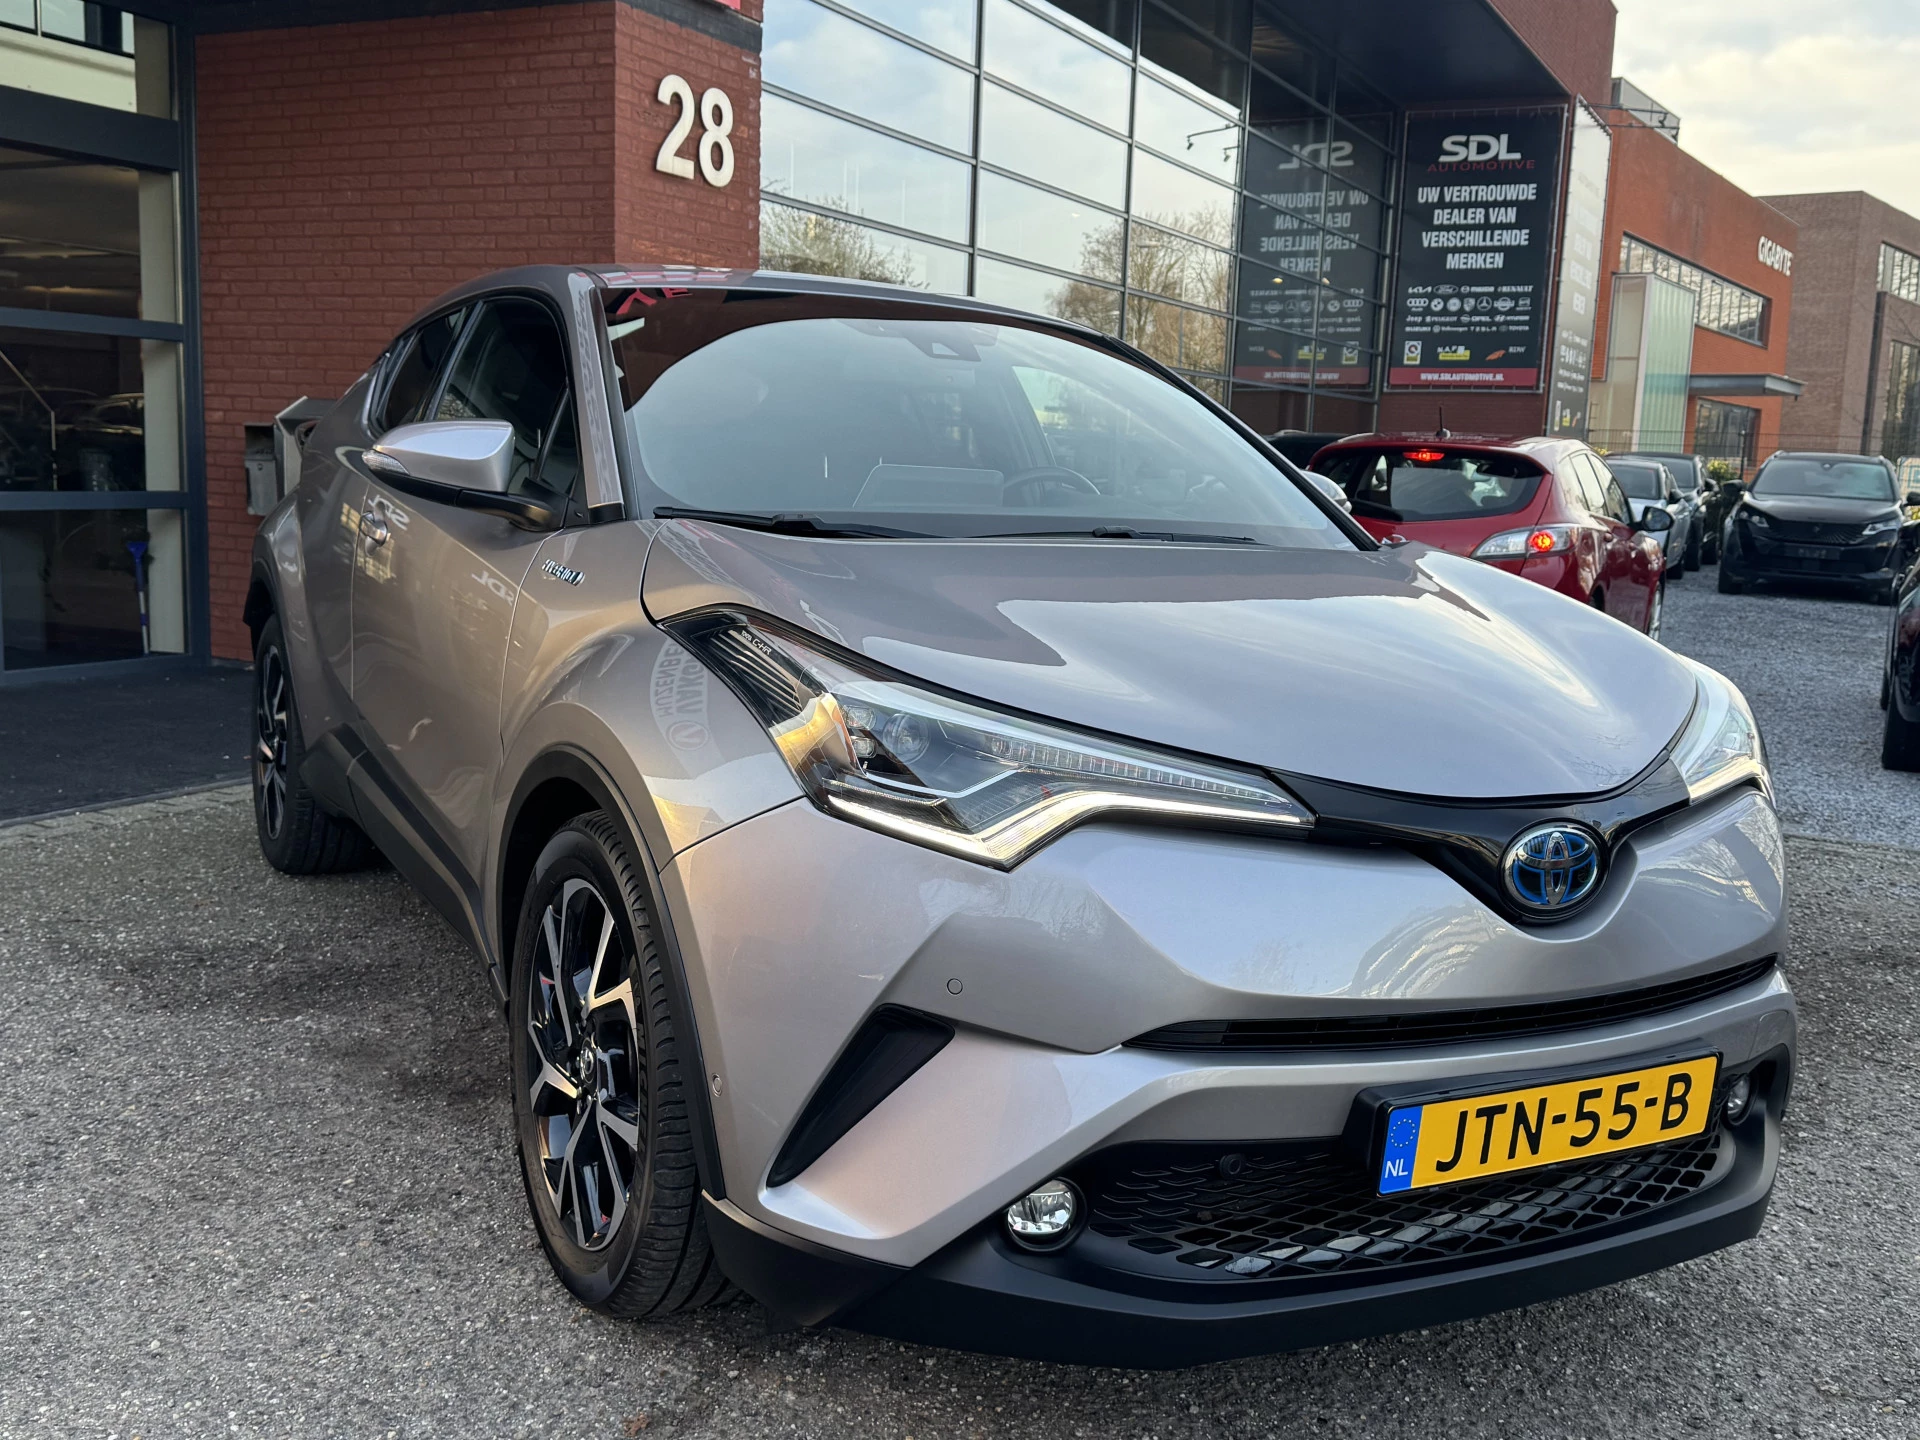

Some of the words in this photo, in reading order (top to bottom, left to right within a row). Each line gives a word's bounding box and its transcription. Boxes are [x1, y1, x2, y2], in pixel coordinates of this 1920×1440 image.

[656, 74, 735, 188] 28
[1438, 133, 1522, 162] SDL
[1427, 160, 1535, 173] AUTOMOTIVE
[1417, 186, 1440, 204] UW
[1443, 183, 1537, 203] VERTROUWDE
[1433, 208, 1485, 225] DEALER
[1489, 206, 1517, 224] VAN
[1422, 229, 1530, 248] VERSCHILLENDE
[1446, 252, 1504, 270] MERKEN
[1758, 235, 1794, 277] GIGABYTE
[1435, 1072, 1693, 1173] JTN-55-B
[1385, 1159, 1409, 1179] NL
